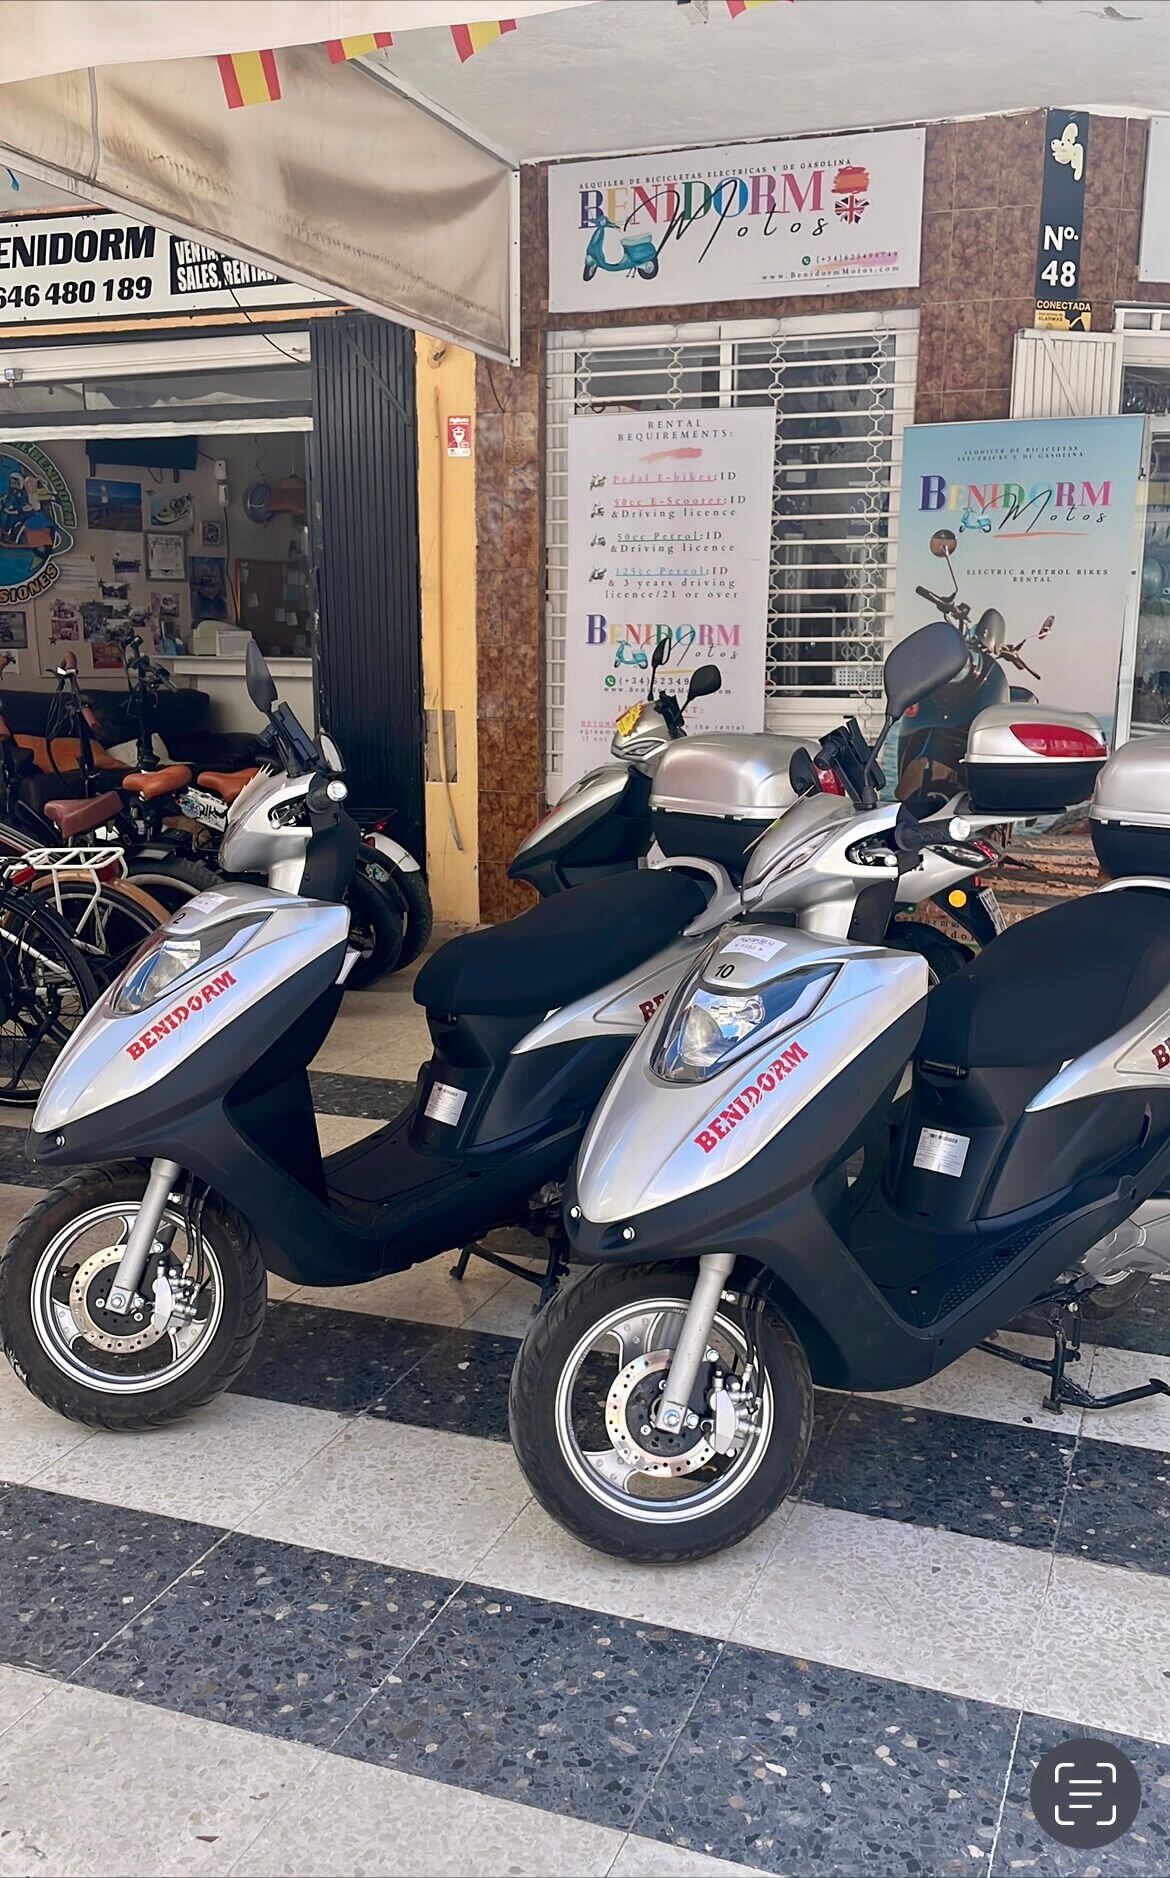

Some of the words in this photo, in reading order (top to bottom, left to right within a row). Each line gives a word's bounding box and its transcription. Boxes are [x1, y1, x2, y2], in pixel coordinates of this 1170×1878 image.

[579, 180, 624, 190] ALQUILER
[800, 159, 851, 169] GASOLINA
[578, 170, 825, 229] BENIDORM
[623, 177, 828, 263] Motos
[177, 262, 222, 292] SALES,
[222, 260, 278, 286] RENT,
[1041, 260, 1076, 287] 48
[45, 280, 96, 305] 480
[102, 276, 152, 301] 189
[1036, 300, 1091, 311] CONECTADA
[618, 430, 735, 441] REQUIREMENTS:
[648, 419, 702, 429] RENTAL
[917, 474, 1112, 512] BENIDORM
[683, 508, 736, 517] licence
[981, 489, 1108, 534] Motos
[682, 543, 736, 552] licence
[680, 577, 736, 589] driving
[585, 614, 742, 647] BENIDORM
[173, 912, 186, 924] 2
[715, 963, 735, 978] 10
[126, 970, 237, 1061] BENIDORM
[694, 1041, 809, 1154] BENIDORM
